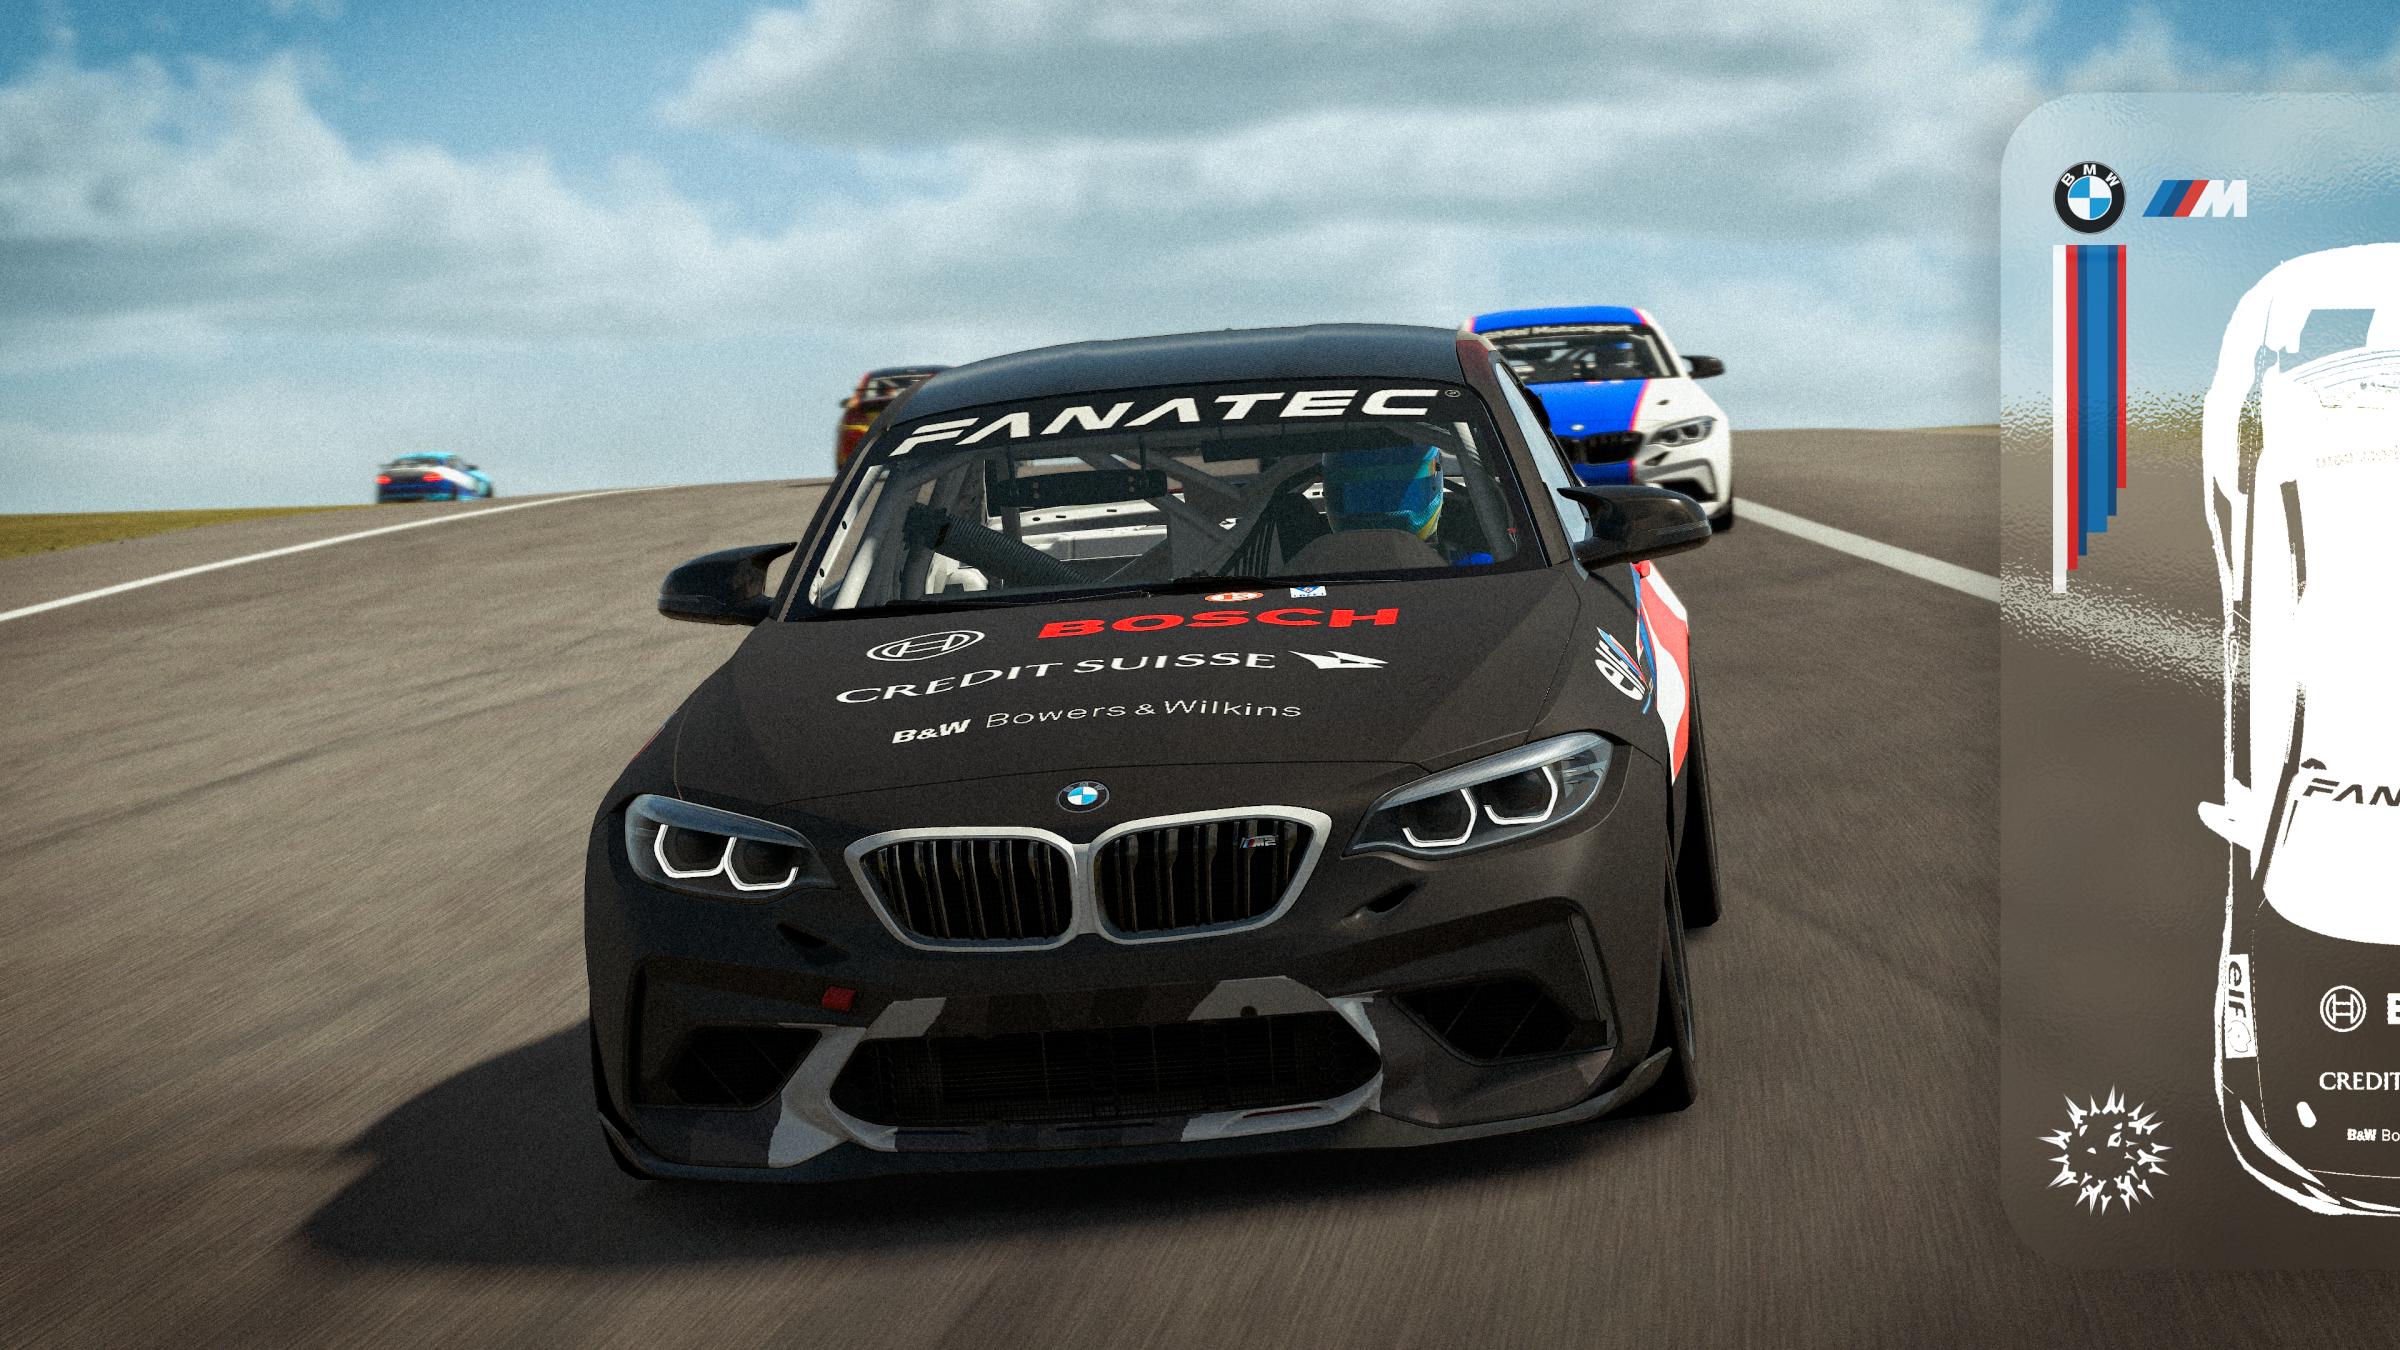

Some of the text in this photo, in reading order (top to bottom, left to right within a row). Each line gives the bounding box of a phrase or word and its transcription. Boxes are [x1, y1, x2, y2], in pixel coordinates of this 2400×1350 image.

[888, 389, 1438, 457] FANATEC
[1038, 608, 1399, 638] BOSCH
[836, 652, 1275, 703] CREDIT SUISSE
[892, 699, 1302, 743] B&W Bowers & Wilkins
